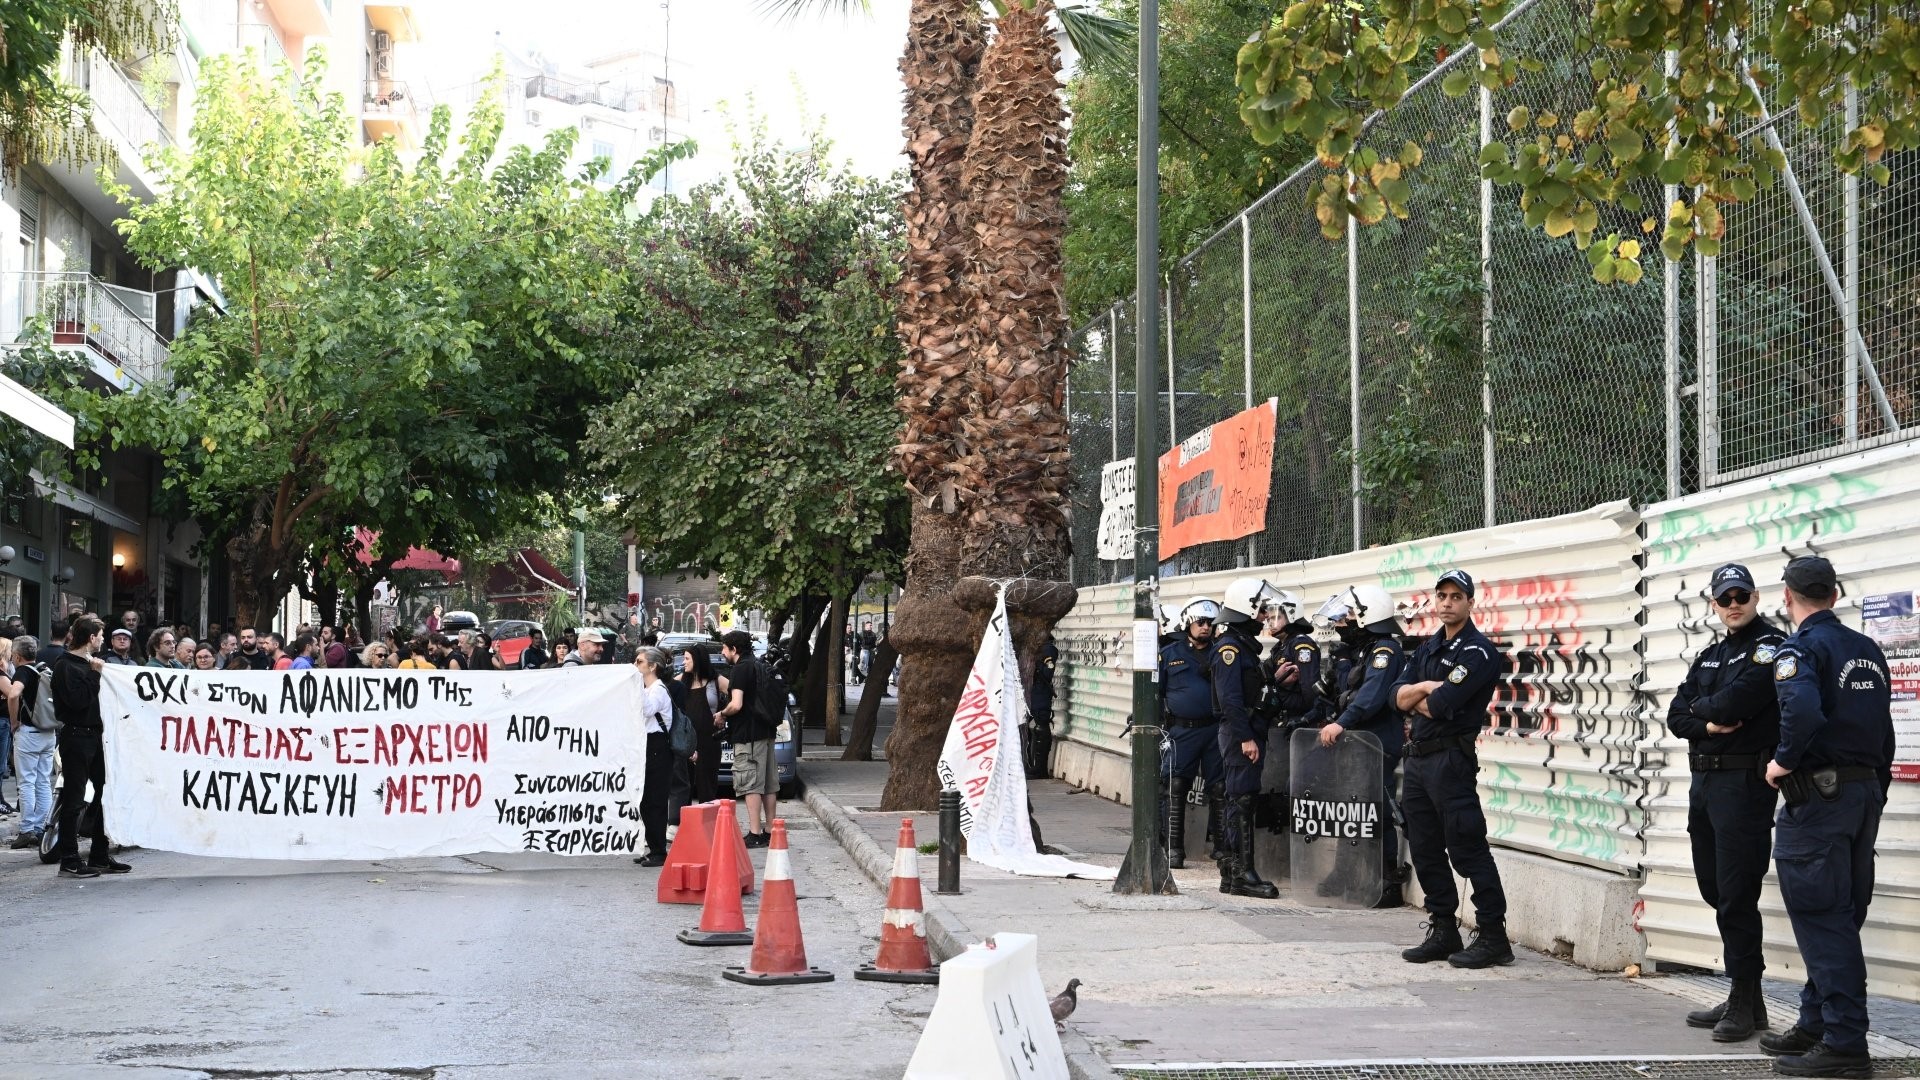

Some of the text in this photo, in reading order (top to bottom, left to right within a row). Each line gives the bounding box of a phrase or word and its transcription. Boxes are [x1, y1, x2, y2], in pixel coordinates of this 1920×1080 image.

[1700, 661, 1721, 669] POLICE
[134, 671, 190, 706] ΟΧΙ
[279, 671, 419, 719] ΑΦΑΝΙΣΜΟ
[1851, 681, 1875, 690] POLICE
[160, 715, 313, 762] ΠΛΑΤΕΙΑΣ
[506, 714, 599, 757] ΑΠΟ ΤΗΝ
[182, 769, 482, 818] ΚΑΤΑΣΚΕΥΗ ΜΕΤΡΟ
[1292, 798, 1379, 823] ΑΣΤΥΝΟΜΙΑ
[1295, 817, 1375, 839] POLICE
